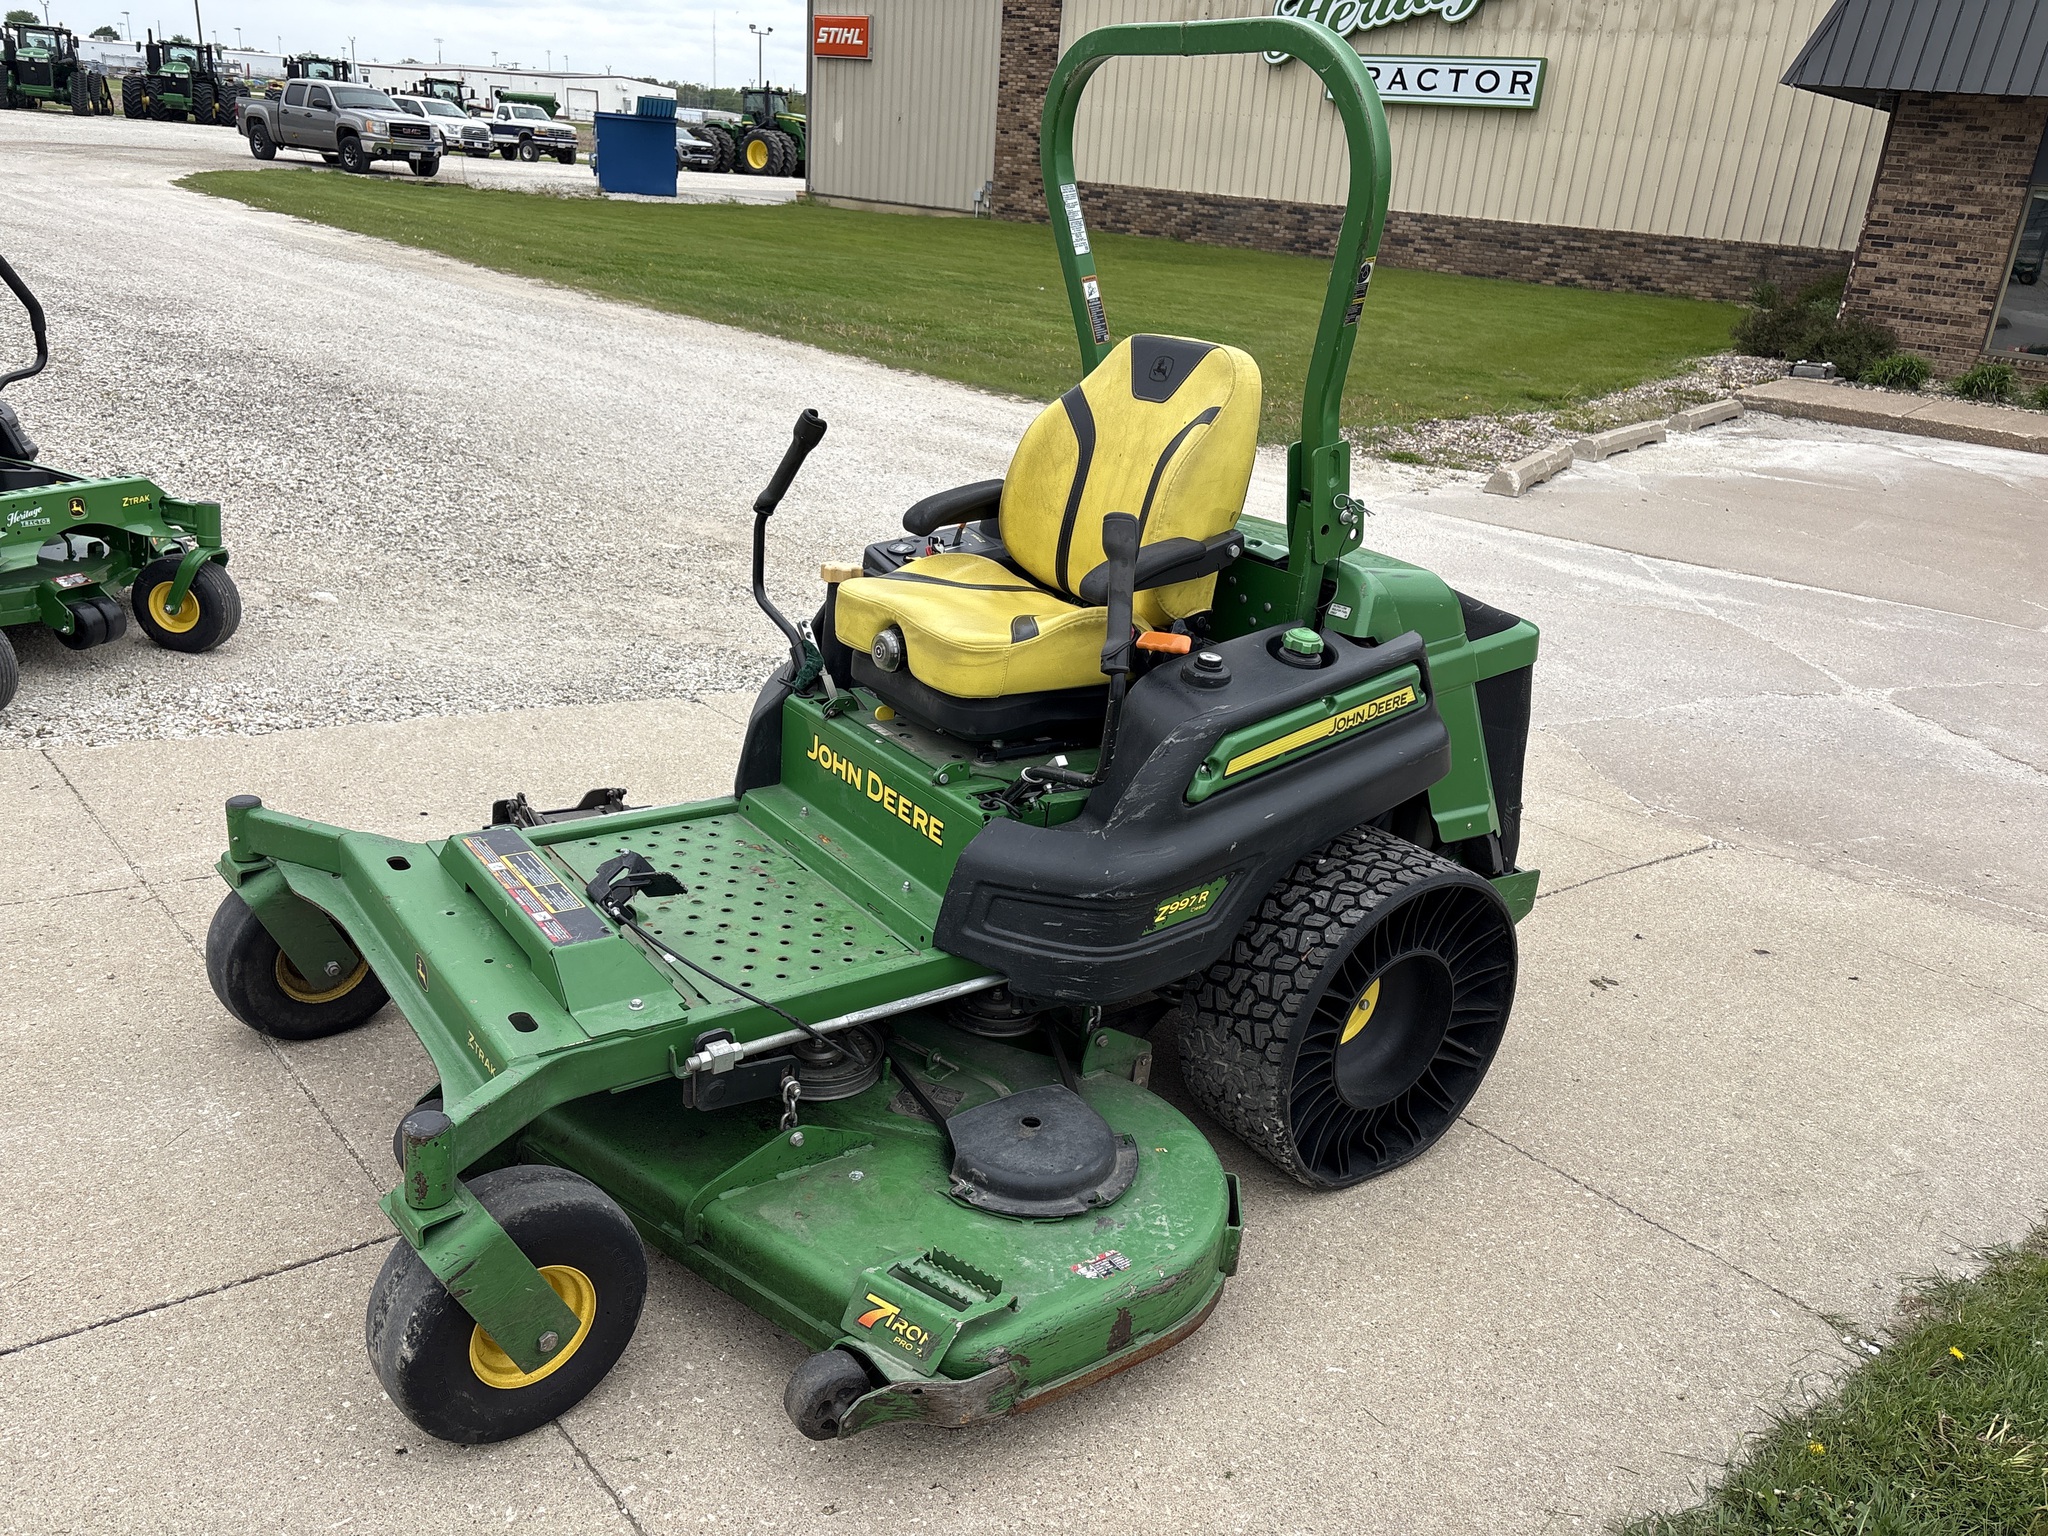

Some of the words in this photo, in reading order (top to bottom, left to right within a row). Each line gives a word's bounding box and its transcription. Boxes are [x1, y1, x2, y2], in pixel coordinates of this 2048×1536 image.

[816, 27, 863, 45] STIHL
[1367, 67, 1533, 95] RACTOR
[122, 495, 150, 507] ZTRAK
[7, 506, 42, 527] Heritage
[20, 518, 50, 527] TRACTOR
[1328, 709, 1365, 735] JOHN
[1367, 692, 1408, 718] DEERE
[807, 733, 862, 791] JOHN
[866, 769, 945, 847] DEERE
[1154, 890, 1210, 923] Z997R
[468, 1030, 496, 1078] ZTRAK
[893, 1336, 913, 1351] PRO
